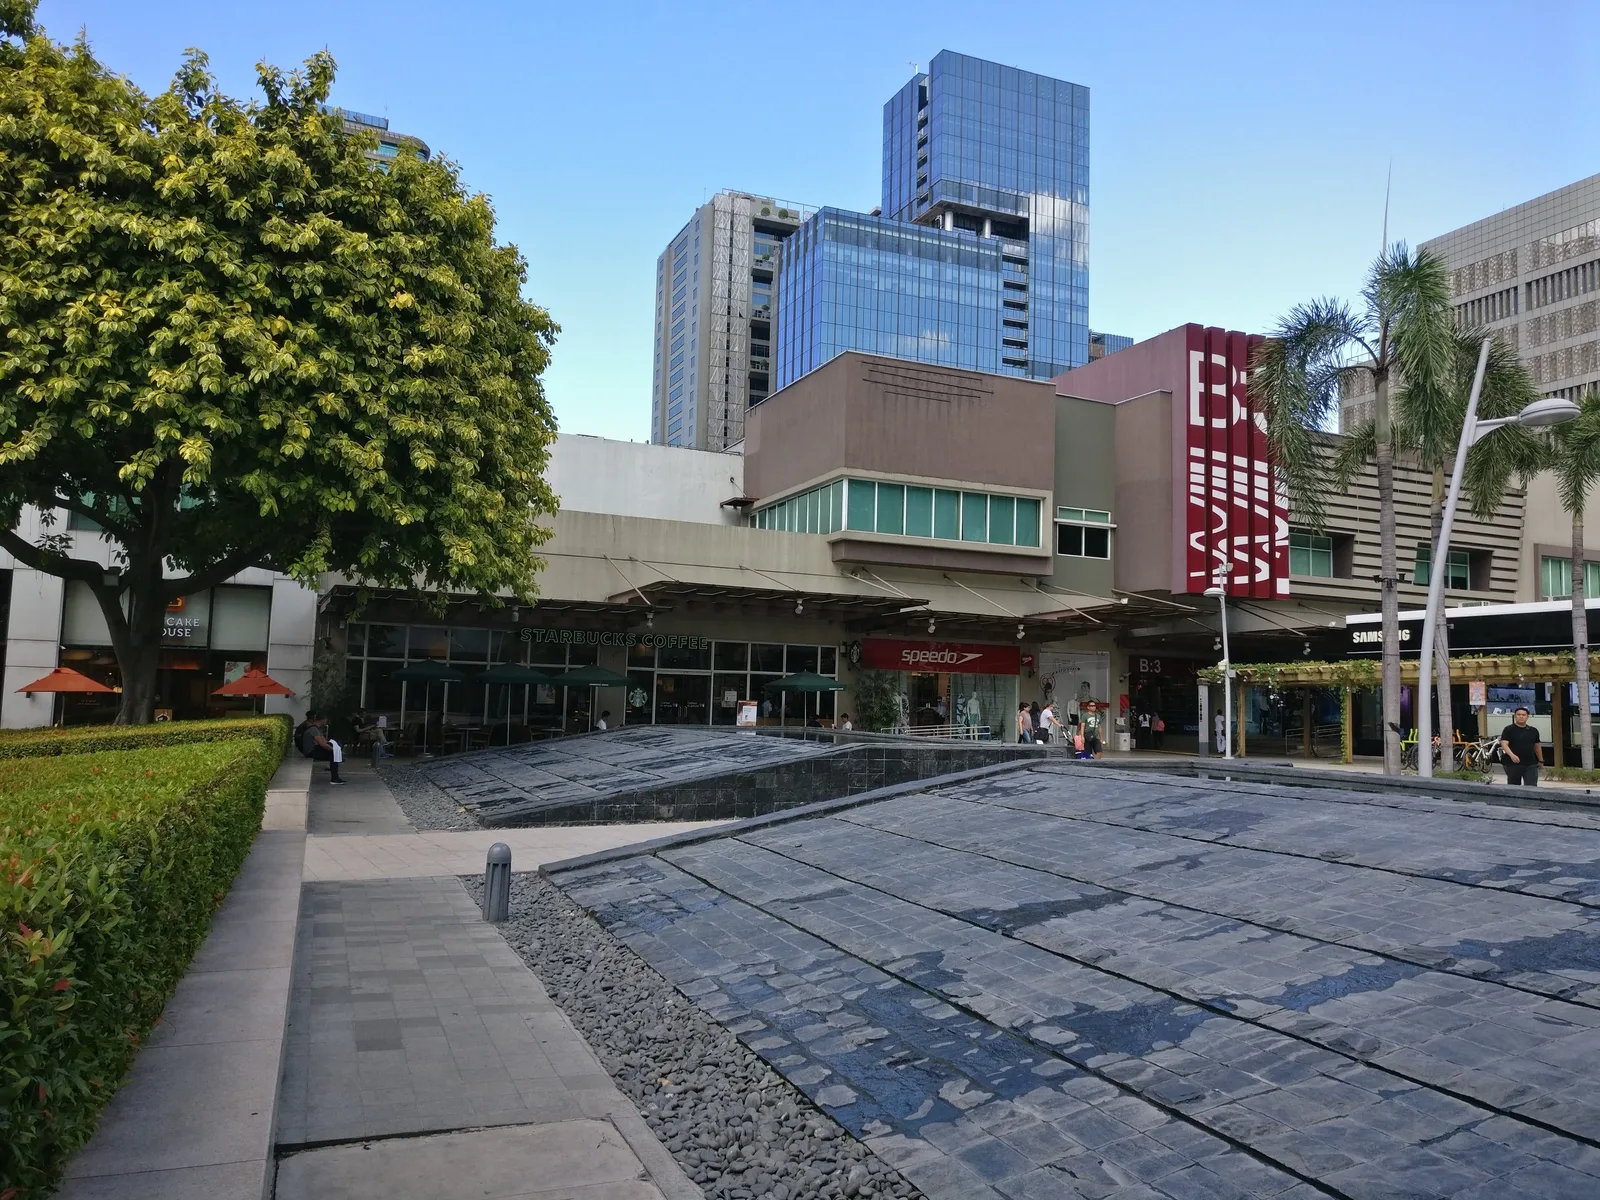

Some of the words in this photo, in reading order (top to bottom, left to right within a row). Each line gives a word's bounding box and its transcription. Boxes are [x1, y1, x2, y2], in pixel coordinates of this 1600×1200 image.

[165, 617, 200, 627] CAKE
[162, 628, 192, 637] OUSE
[520, 627, 637, 647] STARBUCKS
[641, 633, 708, 650] COFFEE
[1352, 629, 1410, 644] SAMSG
[901, 648, 957, 665] speedo
[1139, 658, 1161, 673] B:3
